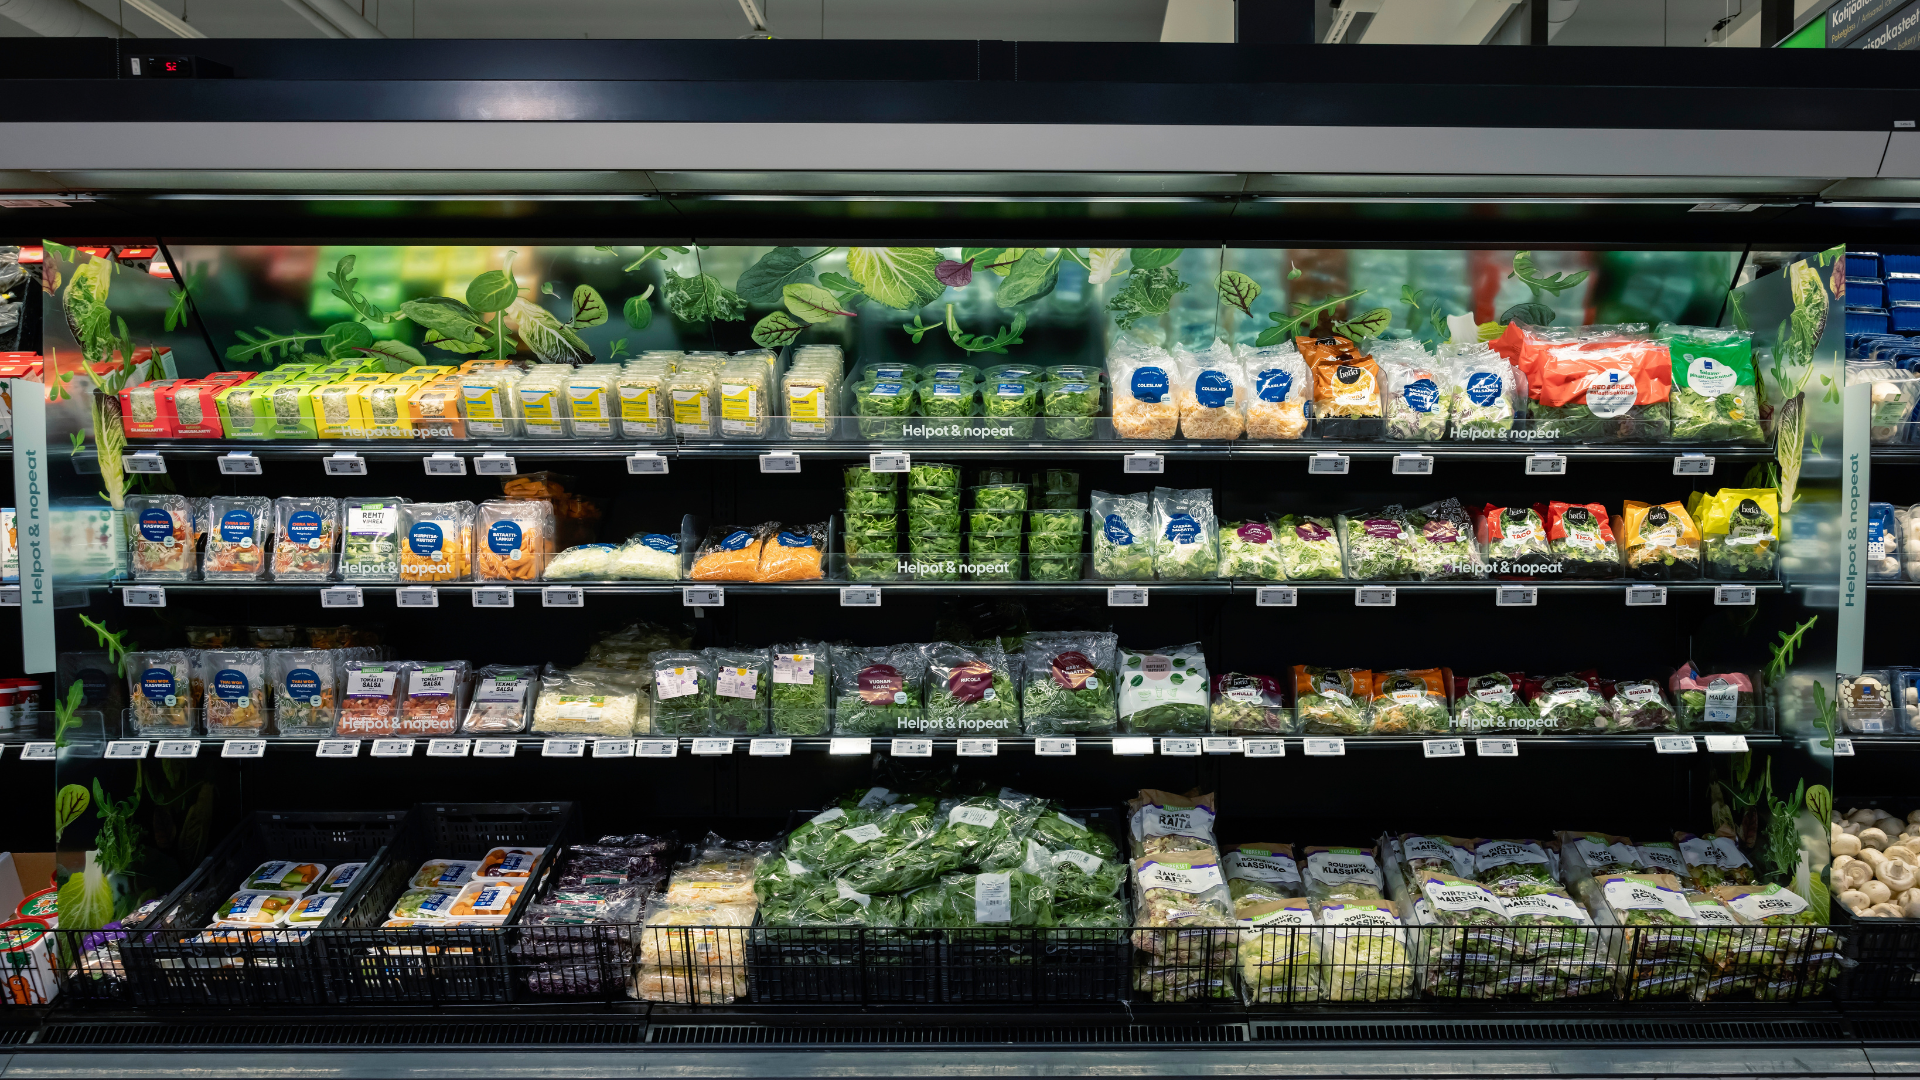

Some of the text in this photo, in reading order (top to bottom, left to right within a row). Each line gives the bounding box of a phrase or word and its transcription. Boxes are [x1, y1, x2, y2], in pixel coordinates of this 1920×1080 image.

[342, 426, 388, 439] Helpot
[403, 426, 454, 439] nopeat
[903, 424, 1014, 438] Helpot & nopeat
[1450, 426, 1560, 441] Helpot & nopeat
[26, 449, 45, 604] Helpot & nopeat
[1845, 453, 1860, 607] Helpot & nopeat
[1512, 530, 1532, 539] TACO
[339, 561, 451, 576] Helpot & nopeat
[898, 561, 1009, 575] Helpot & nopeat
[1452, 562, 1562, 576] Helpot & nopeat
[343, 717, 454, 731] Helpot & nopeat
[898, 717, 1008, 731] Helpot & nopeat
[1449, 716, 1559, 730] Helpot & nopeat
[1159, 816, 1192, 829] RAITA
[1236, 862, 1286, 873] KLASSIKKO
[1323, 866, 1374, 875] KLASSIKKO
[1436, 894, 1490, 903] MAISTUVA
